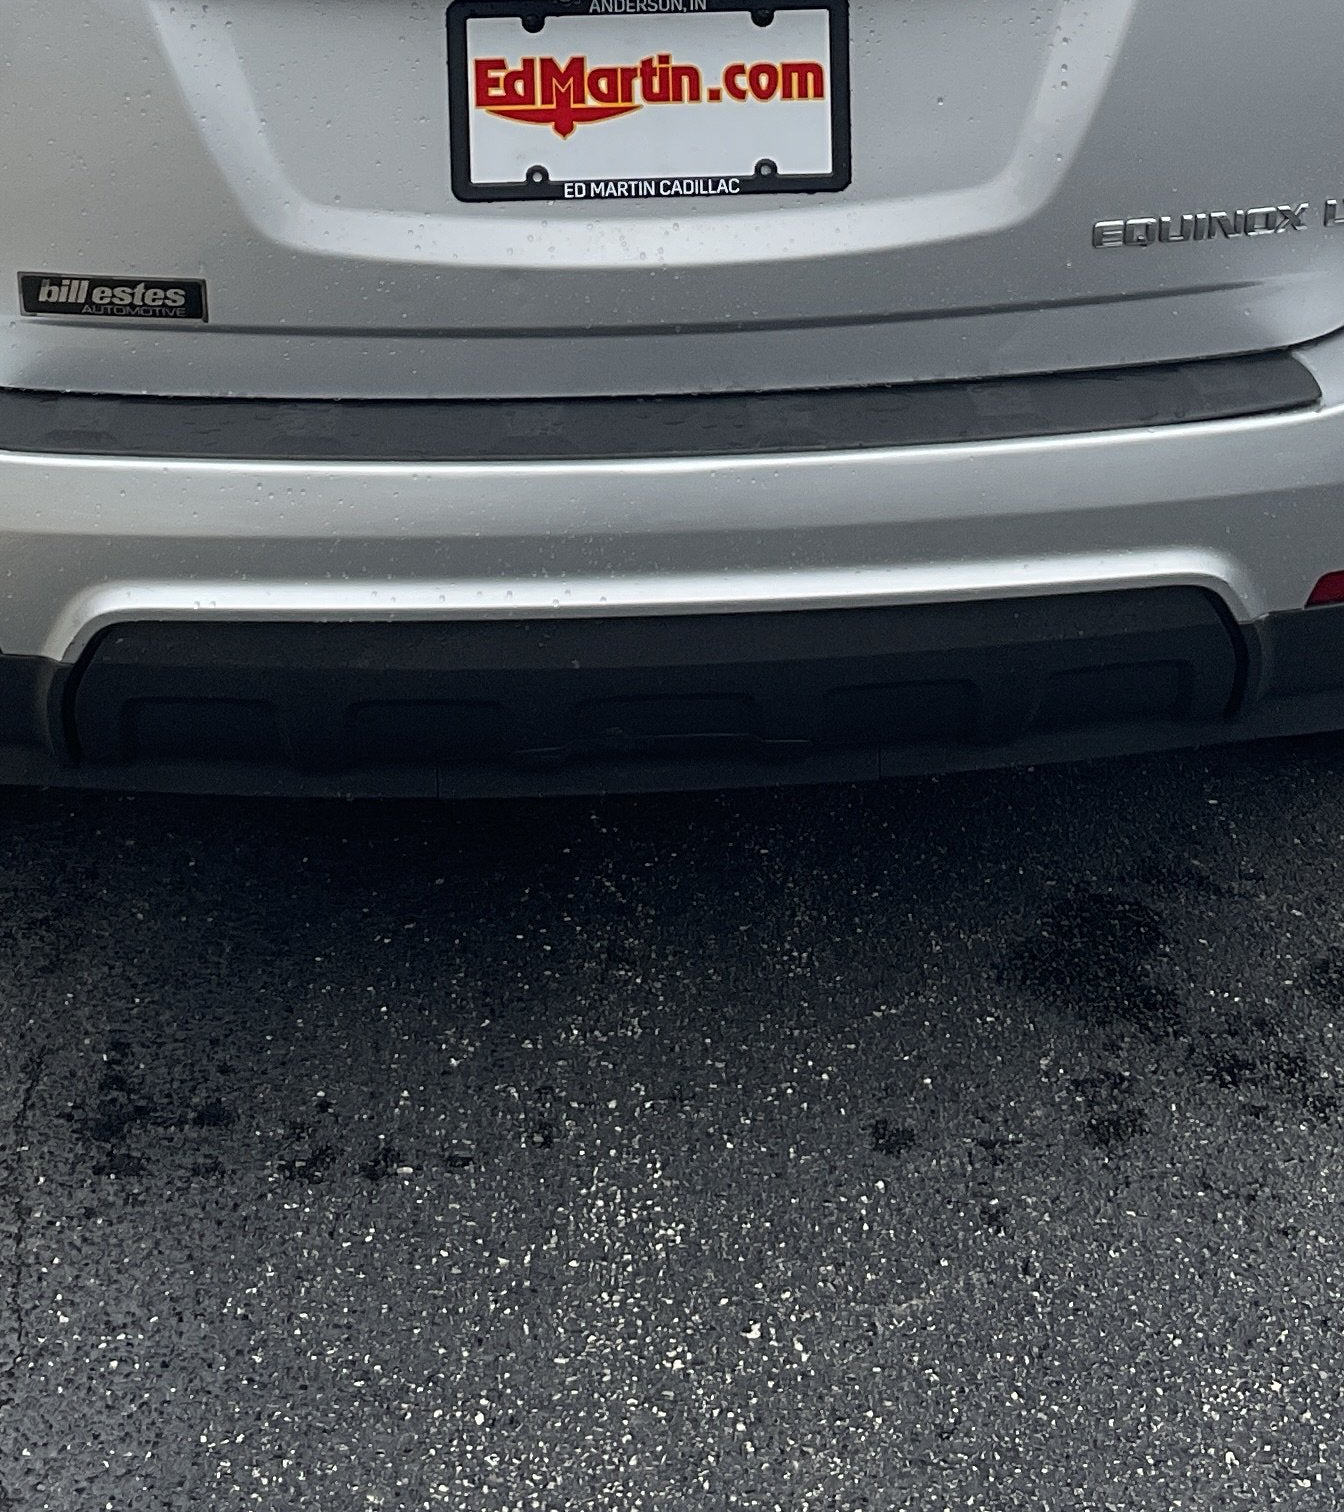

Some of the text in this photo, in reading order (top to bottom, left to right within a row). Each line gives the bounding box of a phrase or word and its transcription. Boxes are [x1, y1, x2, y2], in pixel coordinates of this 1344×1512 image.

[472, 52, 825, 110] EdMartin.com
[564, 178, 740, 198] ED MARTIN CADILLAC
[1092, 202, 1309, 248] EQUINOX
[38, 279, 186, 306] bill estes
[81, 304, 187, 317] AUTOMOTIVE
